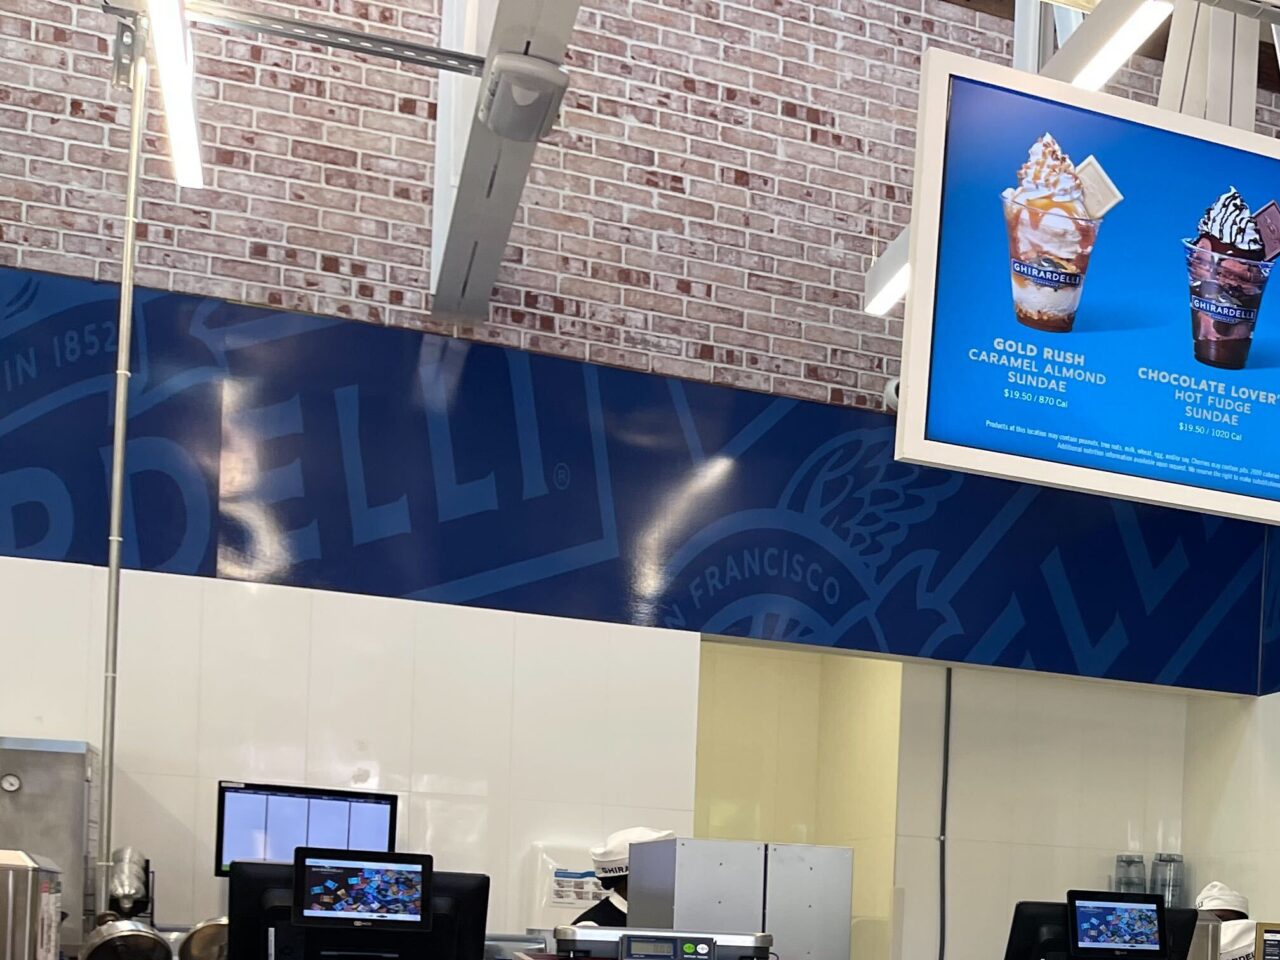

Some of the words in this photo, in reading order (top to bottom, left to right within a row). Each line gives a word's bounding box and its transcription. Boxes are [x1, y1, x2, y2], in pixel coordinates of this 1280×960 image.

[1013, 262, 1080, 284] GHIRARDELLI
[1193, 299, 1254, 319] GHIRARDELLI
[53, 320, 118, 369] 1852
[993, 337, 1038, 356] GOLD
[1042, 347, 1085, 366] RUSH
[968, 348, 1039, 373] CARAMEL
[1043, 363, 1107, 385] ALMOND
[1007, 371, 1067, 393] SUNDAE
[1137, 367, 1226, 395] CHOCOLATE
[1003, 388, 1033, 402] $19.50
[1038, 395, 1054, 406] 870
[1055, 398, 1068, 408] Cal
[1174, 389, 1203, 404] HOT
[1207, 396, 1252, 414] FUDGE
[1184, 405, 1240, 426] SUNDAE
[1178, 422, 1205, 435] $19.50
[1211, 428, 1230, 439] 1020
[1231, 432, 1243, 441] Cal
[688, 545, 842, 606] FRANCISCO
